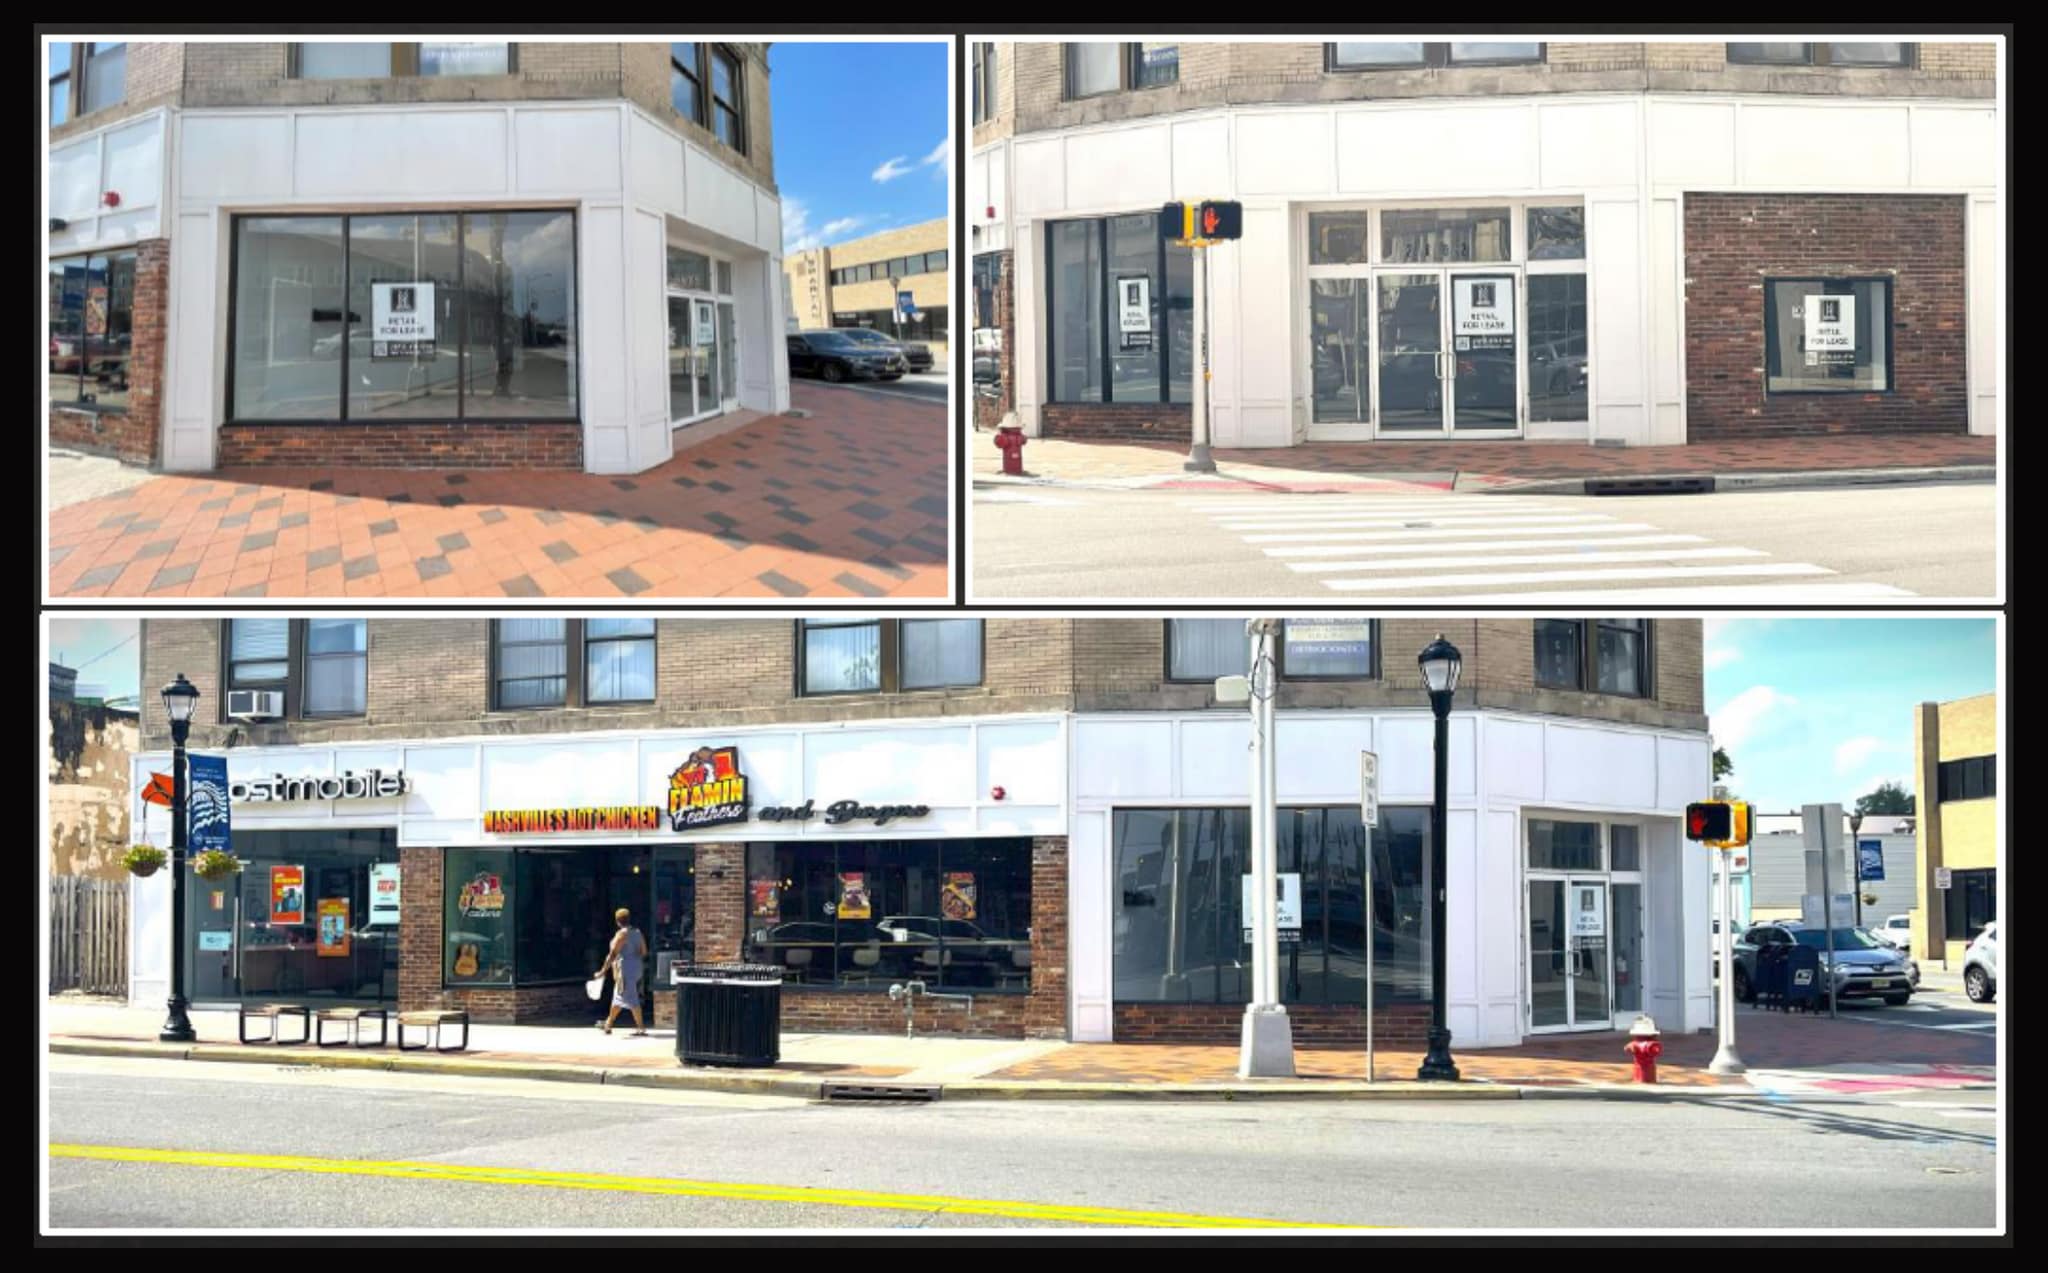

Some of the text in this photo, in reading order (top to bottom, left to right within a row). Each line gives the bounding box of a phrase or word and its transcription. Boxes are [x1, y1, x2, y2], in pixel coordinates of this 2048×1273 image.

[1463, 321, 1479, 329] FOR
[229, 768, 404, 801] ostmobile
[670, 777, 743, 815] FLAMIN
[567, 808, 594, 831] HOT
[597, 806, 660, 831] CHICKEN
[758, 799, 814, 822] and
